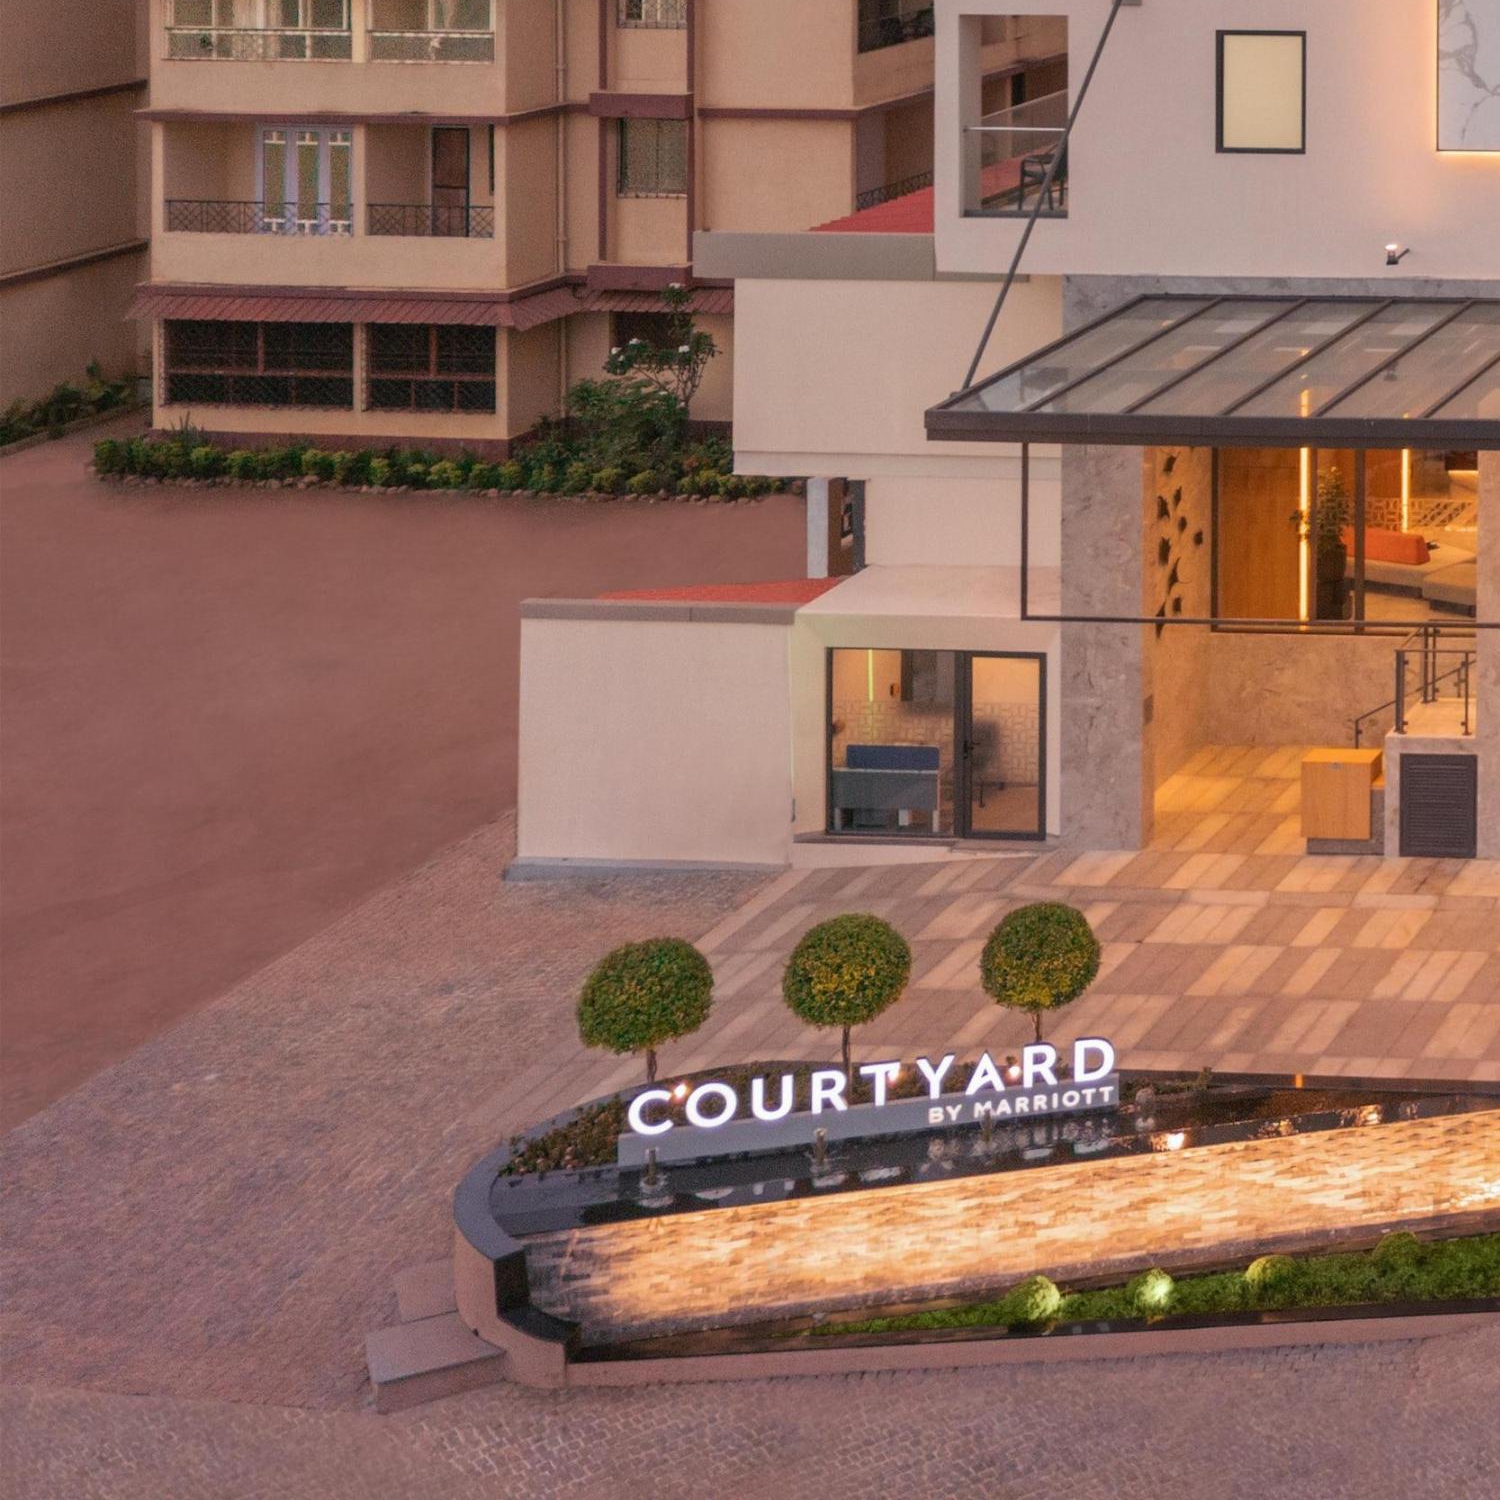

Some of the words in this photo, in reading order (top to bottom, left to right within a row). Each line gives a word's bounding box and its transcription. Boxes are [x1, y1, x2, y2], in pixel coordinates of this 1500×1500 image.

[627, 1038, 1115, 1135] COURTYARD
[928, 1104, 962, 1124] BY
[973, 1086, 1114, 1118] MARRIOTT
